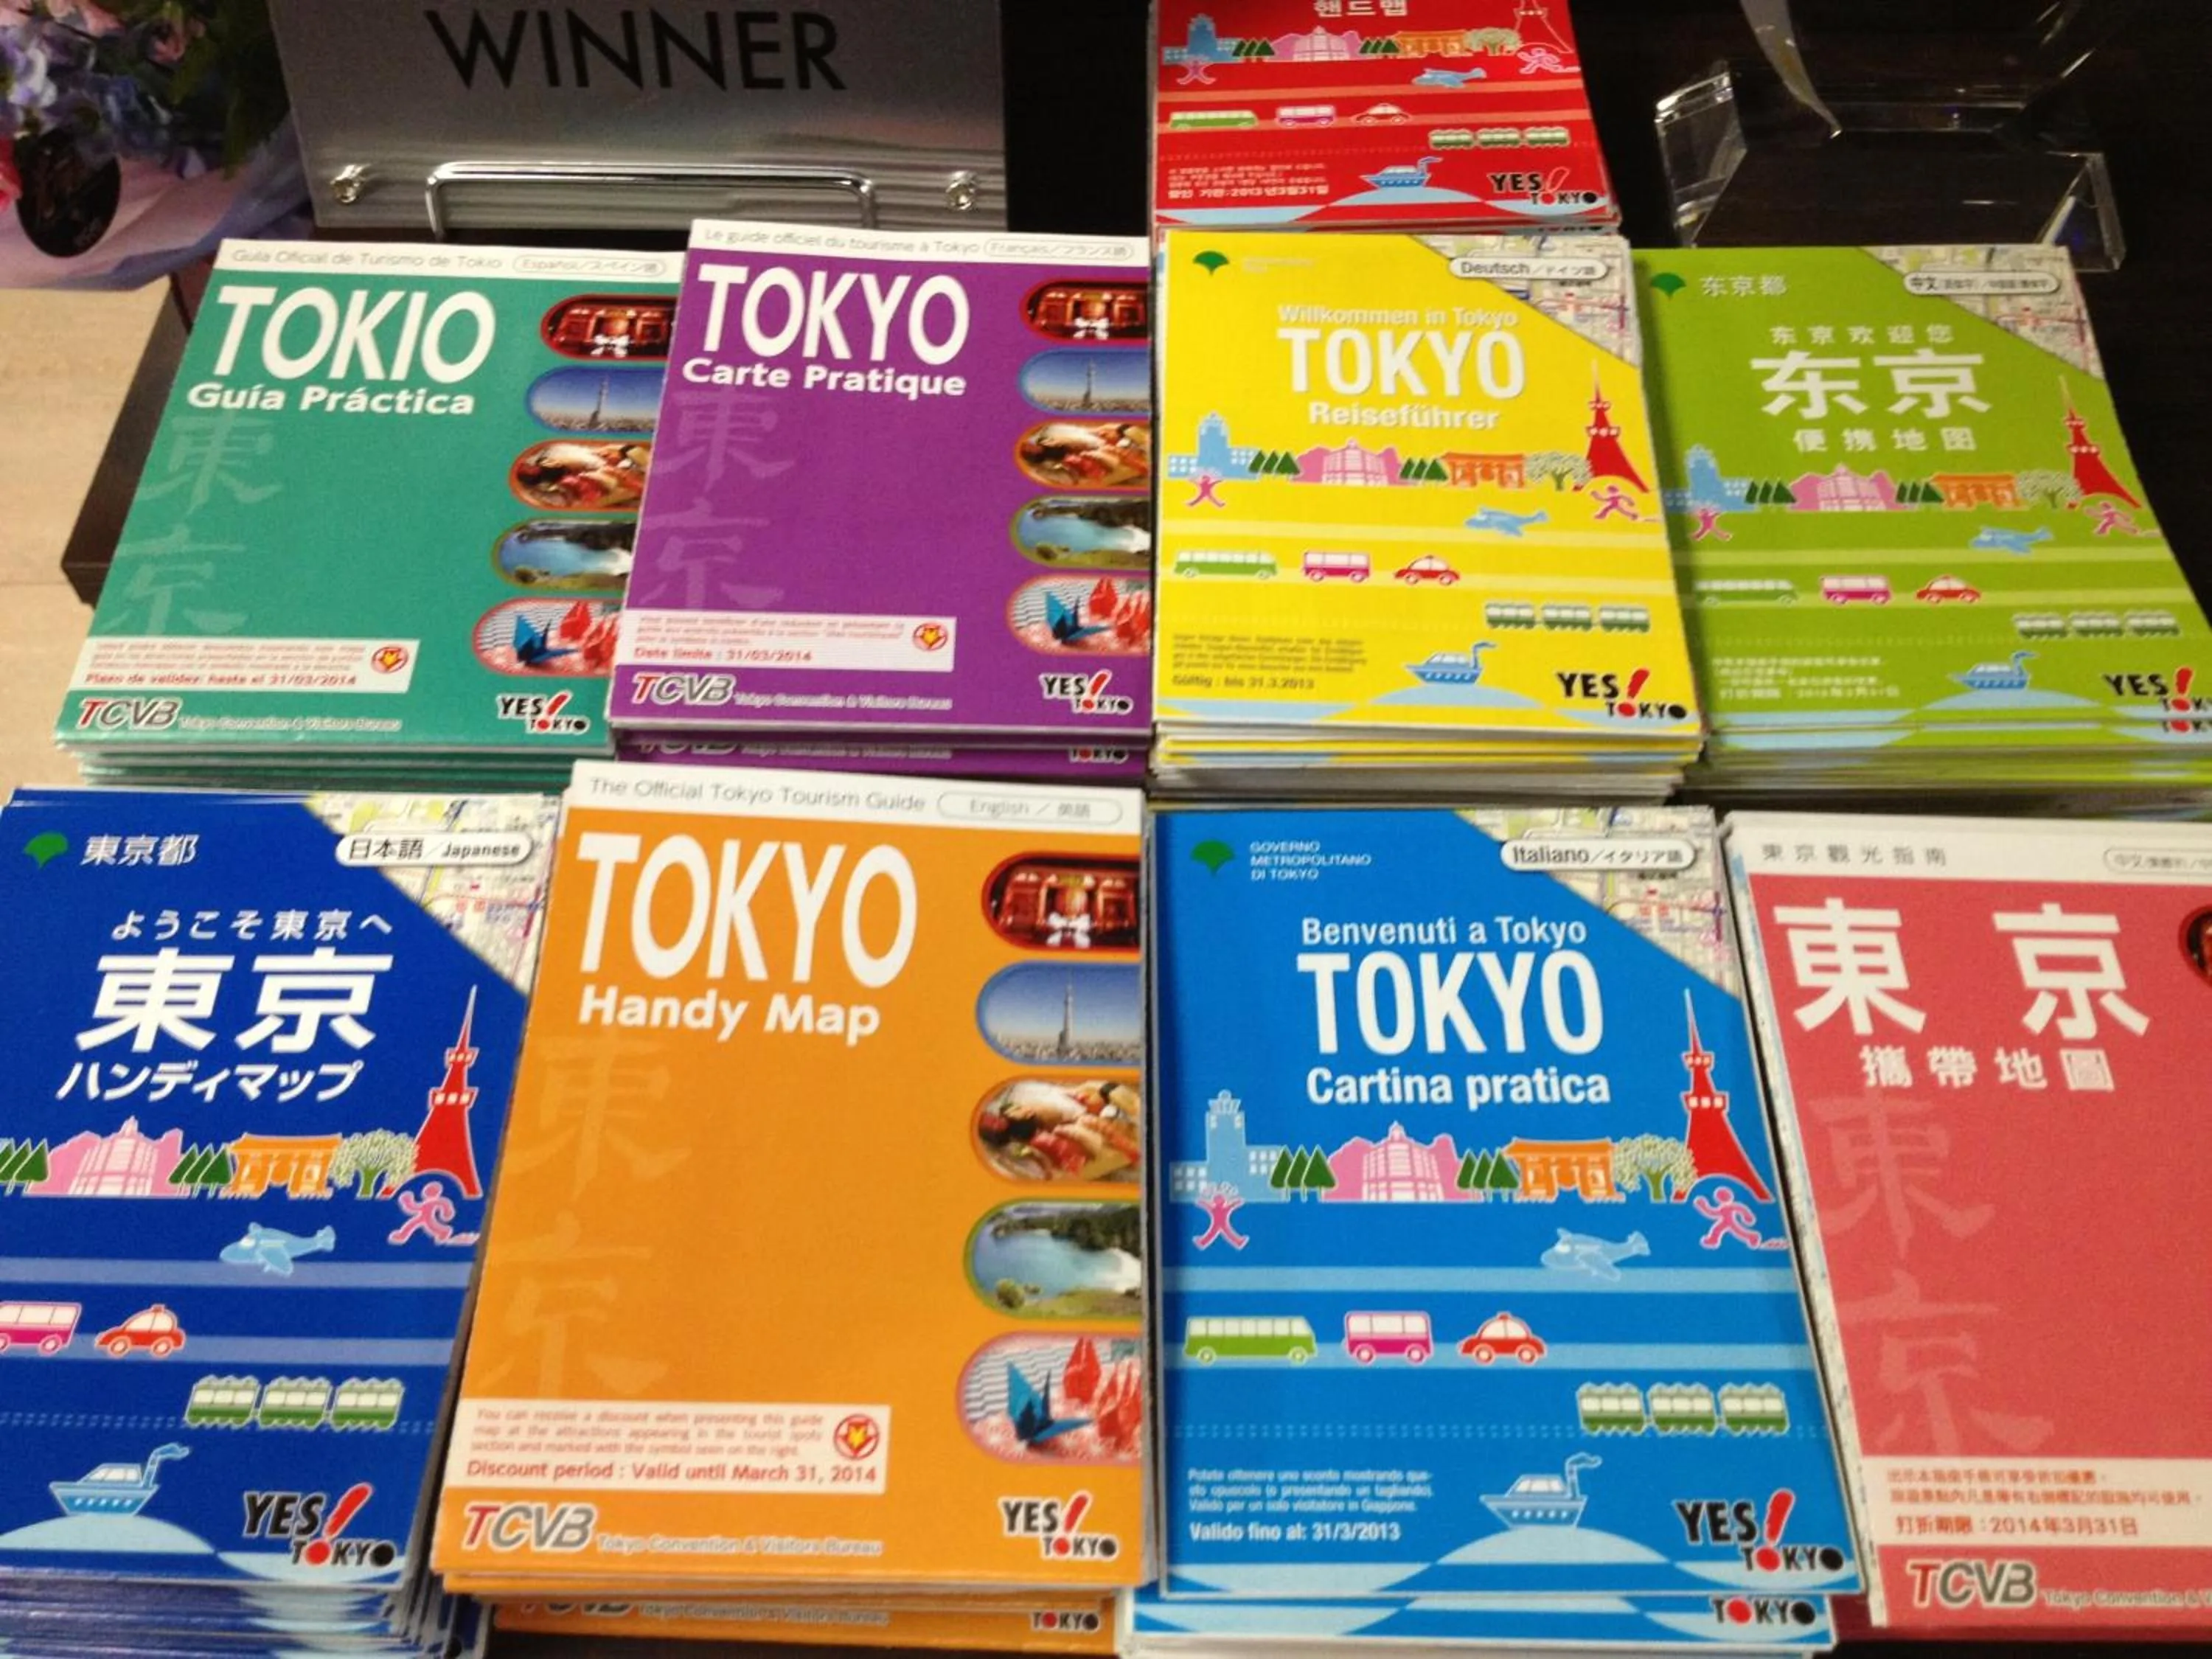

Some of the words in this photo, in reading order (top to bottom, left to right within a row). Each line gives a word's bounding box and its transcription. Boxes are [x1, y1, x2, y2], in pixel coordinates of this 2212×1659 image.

[426, 8, 847, 91] WINNER
[705, 229, 723, 241] Le
[727, 231, 769, 244] guide
[825, 237, 846, 248] du
[850, 238, 916, 253] tourisme
[936, 240, 981, 254] Tokyo
[275, 250, 328, 264] Oficial
[333, 253, 354, 265] de
[360, 253, 424, 266] Turismo
[428, 256, 451, 267] de
[457, 255, 503, 268] Tokio
[1461, 261, 1531, 275] Deutsch
[1700, 274, 1787, 297] 东京都
[698, 263, 970, 366] TOKYO
[1278, 305, 1418, 325] Willkommen
[1425, 306, 1447, 325] in
[1452, 307, 1519, 330] Tokyo
[213, 285, 496, 383] TOKIO
[1276, 327, 1526, 400] TOKYO
[682, 357, 790, 389] Carte
[804, 365, 967, 400] Pratique
[1750, 348, 1992, 419] 东京
[187, 382, 285, 411] Guía
[299, 384, 475, 414] Práctica
[1309, 402, 1500, 429] Reiseführer
[634, 647, 667, 659] Date
[635, 674, 734, 703] TCVB
[77, 698, 181, 728] TCVB
[1606, 700, 1688, 720] TOKYO
[590, 776, 627, 796] The
[634, 778, 703, 800] Official
[710, 783, 773, 807] Tokyo
[780, 787, 860, 808] Tourism
[866, 792, 927, 812] Guide
[970, 798, 1029, 819] English
[80, 833, 200, 867] 東京都
[348, 837, 424, 861] 日本語
[443, 841, 521, 860] Japanese
[1250, 840, 1321, 854] GOVERNO
[1250, 854, 1372, 867] METROPOLITANO
[1251, 868, 1266, 881] DI
[1269, 868, 1319, 881] TOKYO
[576, 832, 918, 988] TOKYO
[111, 908, 393, 942] ようこそ東京へ
[1301, 917, 1458, 946] Benvenuti
[1468, 925, 1489, 945] a
[1495, 917, 1587, 949] Tokyo
[1773, 897, 2150, 1040] 東京
[74, 946, 394, 1053] 東京
[1296, 949, 1604, 1056] TOKYO
[578, 984, 749, 1042] Handy
[764, 993, 881, 1047] Map
[55, 1059, 366, 1104] ハンディマップ
[1306, 1067, 1453, 1105] Cartina
[1467, 1068, 1611, 1111] pratica
[467, 1459, 548, 1476] Discount
[552, 1461, 614, 1482] period
[632, 1462, 681, 1479] Valid
[685, 1463, 726, 1480] until
[731, 1464, 790, 1481] March
[796, 1466, 824, 1484] 31,
[831, 1466, 877, 1482] 2014
[465, 1503, 597, 1551] TCVB
[1189, 1522, 1244, 1542] Valido
[1248, 1522, 1282, 1541] fino
[1312, 1521, 1401, 1542] 31/3/2013
[292, 1540, 394, 1566] TOKYO
[597, 1534, 643, 1555] Tokyo
[1043, 1537, 1117, 1557] TOKYO
[1740, 1547, 1843, 1571] TOKYO
[1908, 1561, 2036, 1606] TCVB
[1032, 1611, 1099, 1631] TOKYO
[1711, 1598, 1816, 1626] TOKYO
